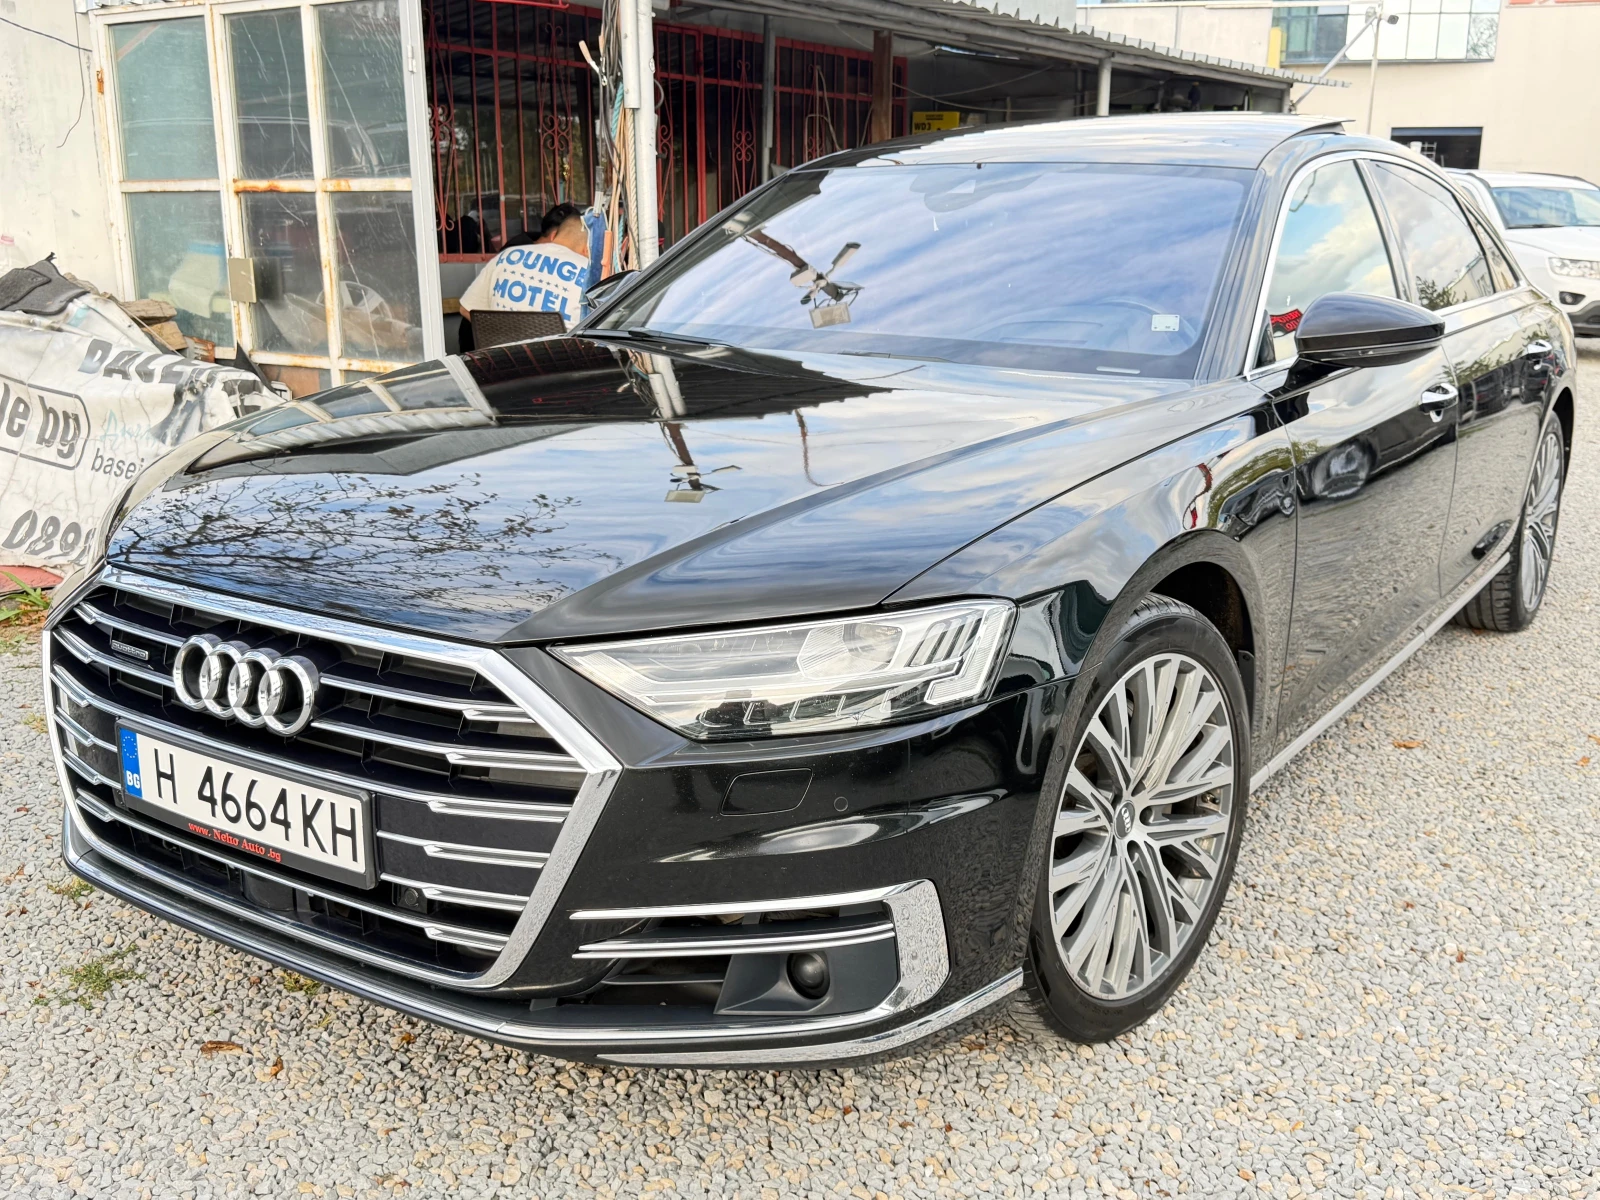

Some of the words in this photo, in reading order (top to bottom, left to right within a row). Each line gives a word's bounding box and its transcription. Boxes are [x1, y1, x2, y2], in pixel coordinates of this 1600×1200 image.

[493, 278, 571, 321] MOTEL
[126, 770, 141, 789] BG
[154, 748, 178, 804] H
[242, 838, 265, 855] Auto
